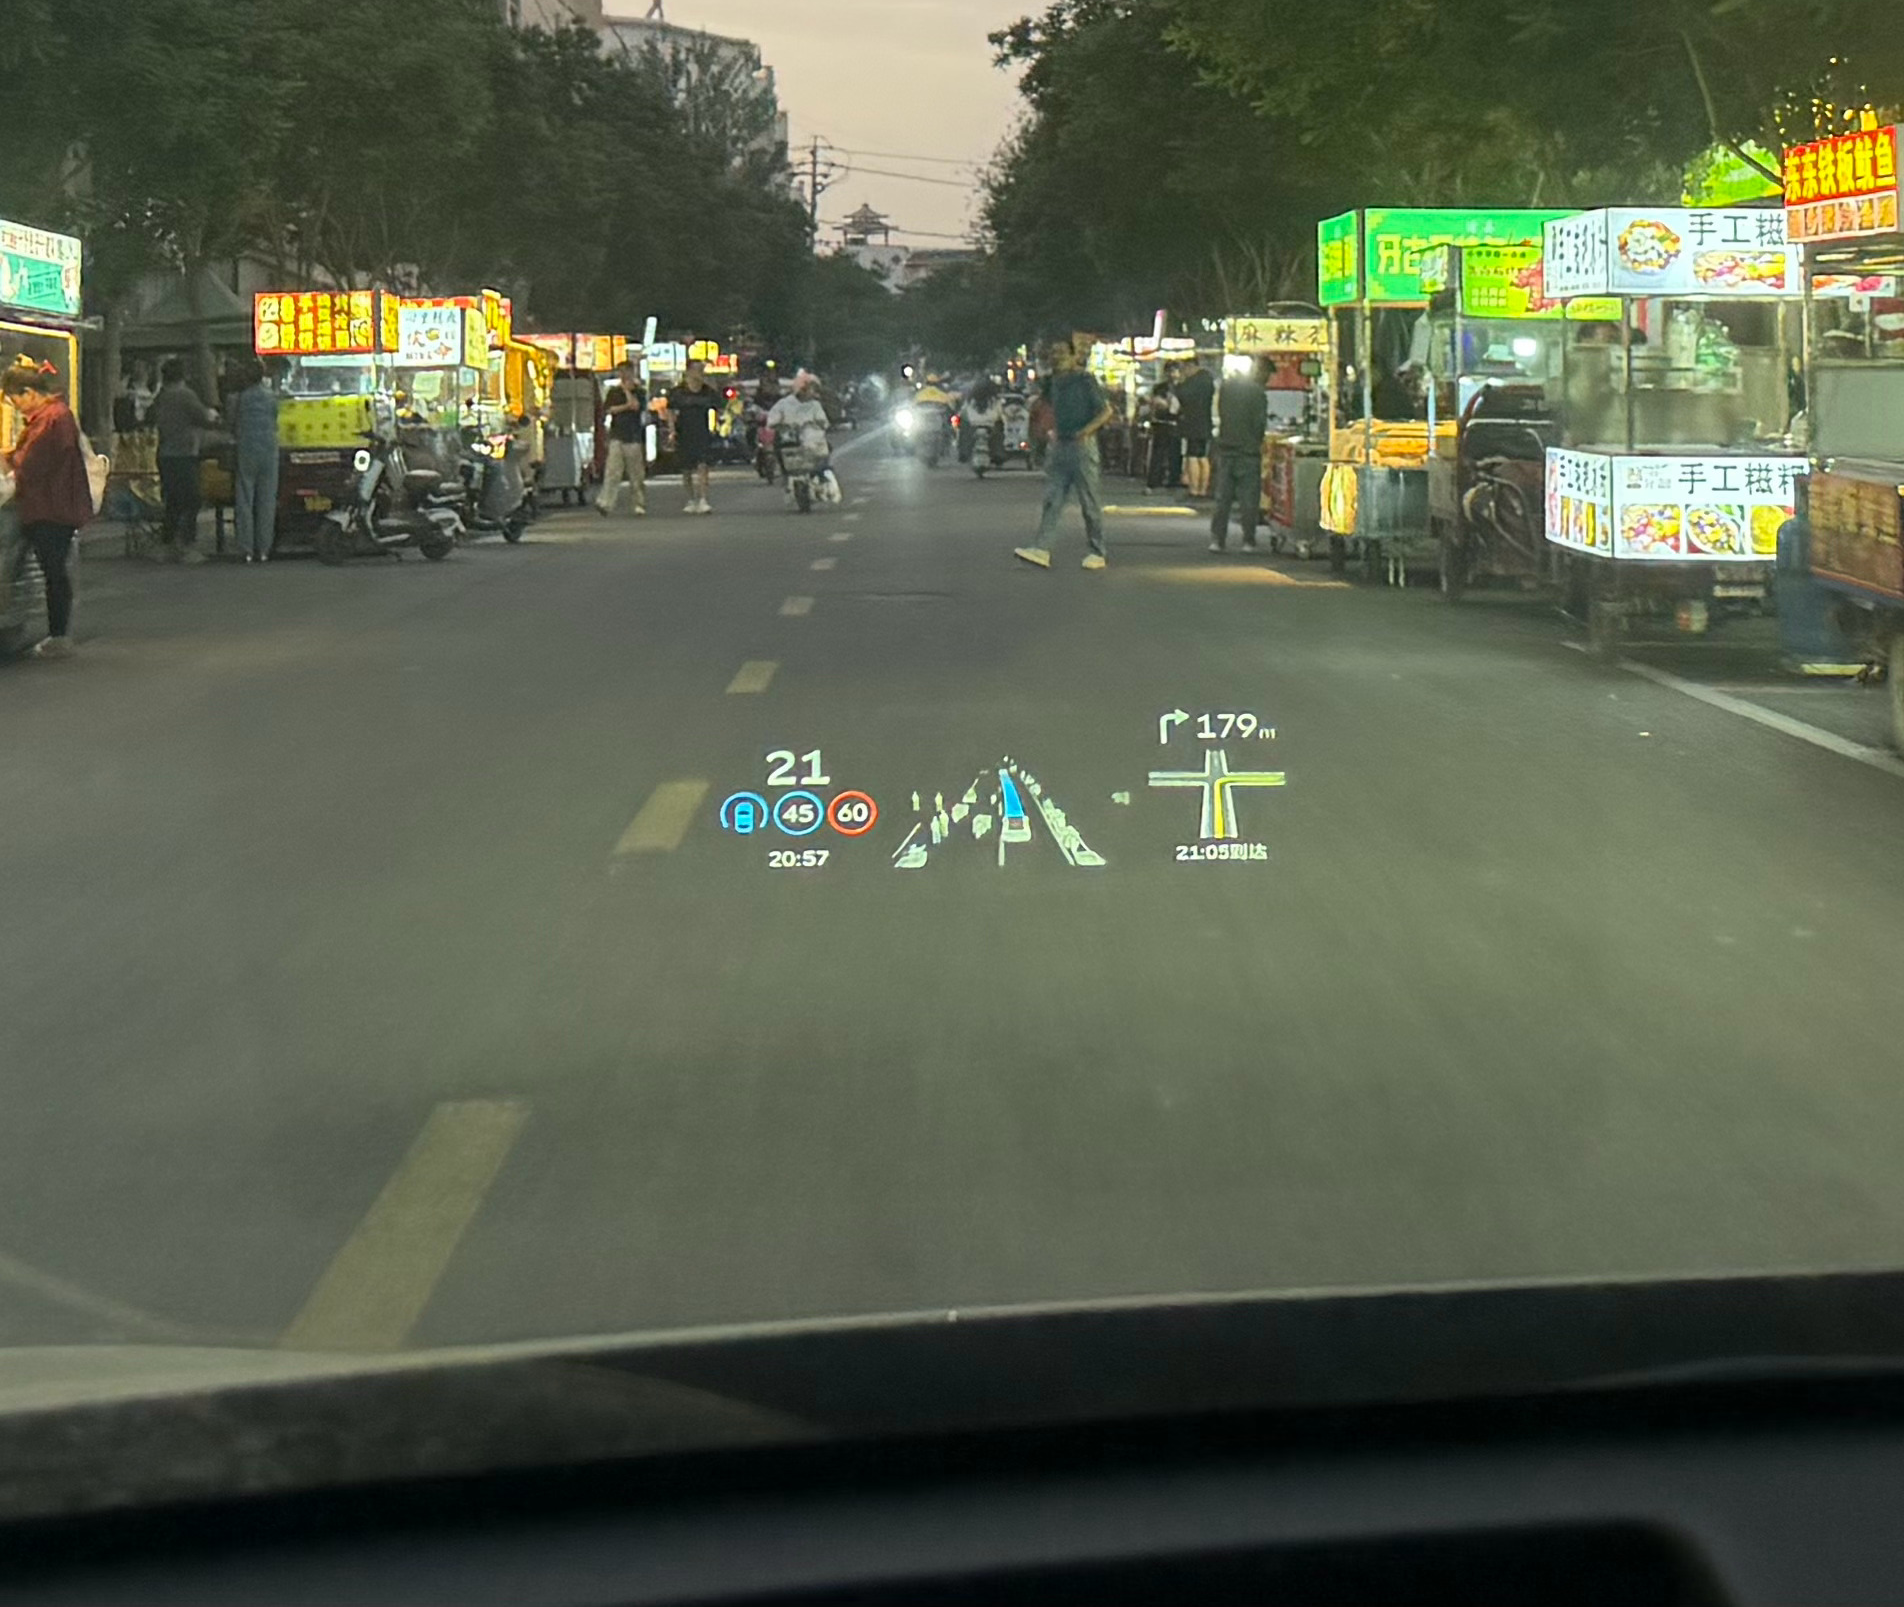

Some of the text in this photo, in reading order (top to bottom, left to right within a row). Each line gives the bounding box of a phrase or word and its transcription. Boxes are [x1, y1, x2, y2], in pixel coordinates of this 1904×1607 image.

[1785, 129, 1896, 202] 东东铁板鱿鱼
[764, 749, 831, 787] 21
[782, 801, 815, 824] 45
[836, 801, 868, 824] 60
[768, 848, 830, 869] 20:57
[1175, 843, 1269, 862] 21:05到达
